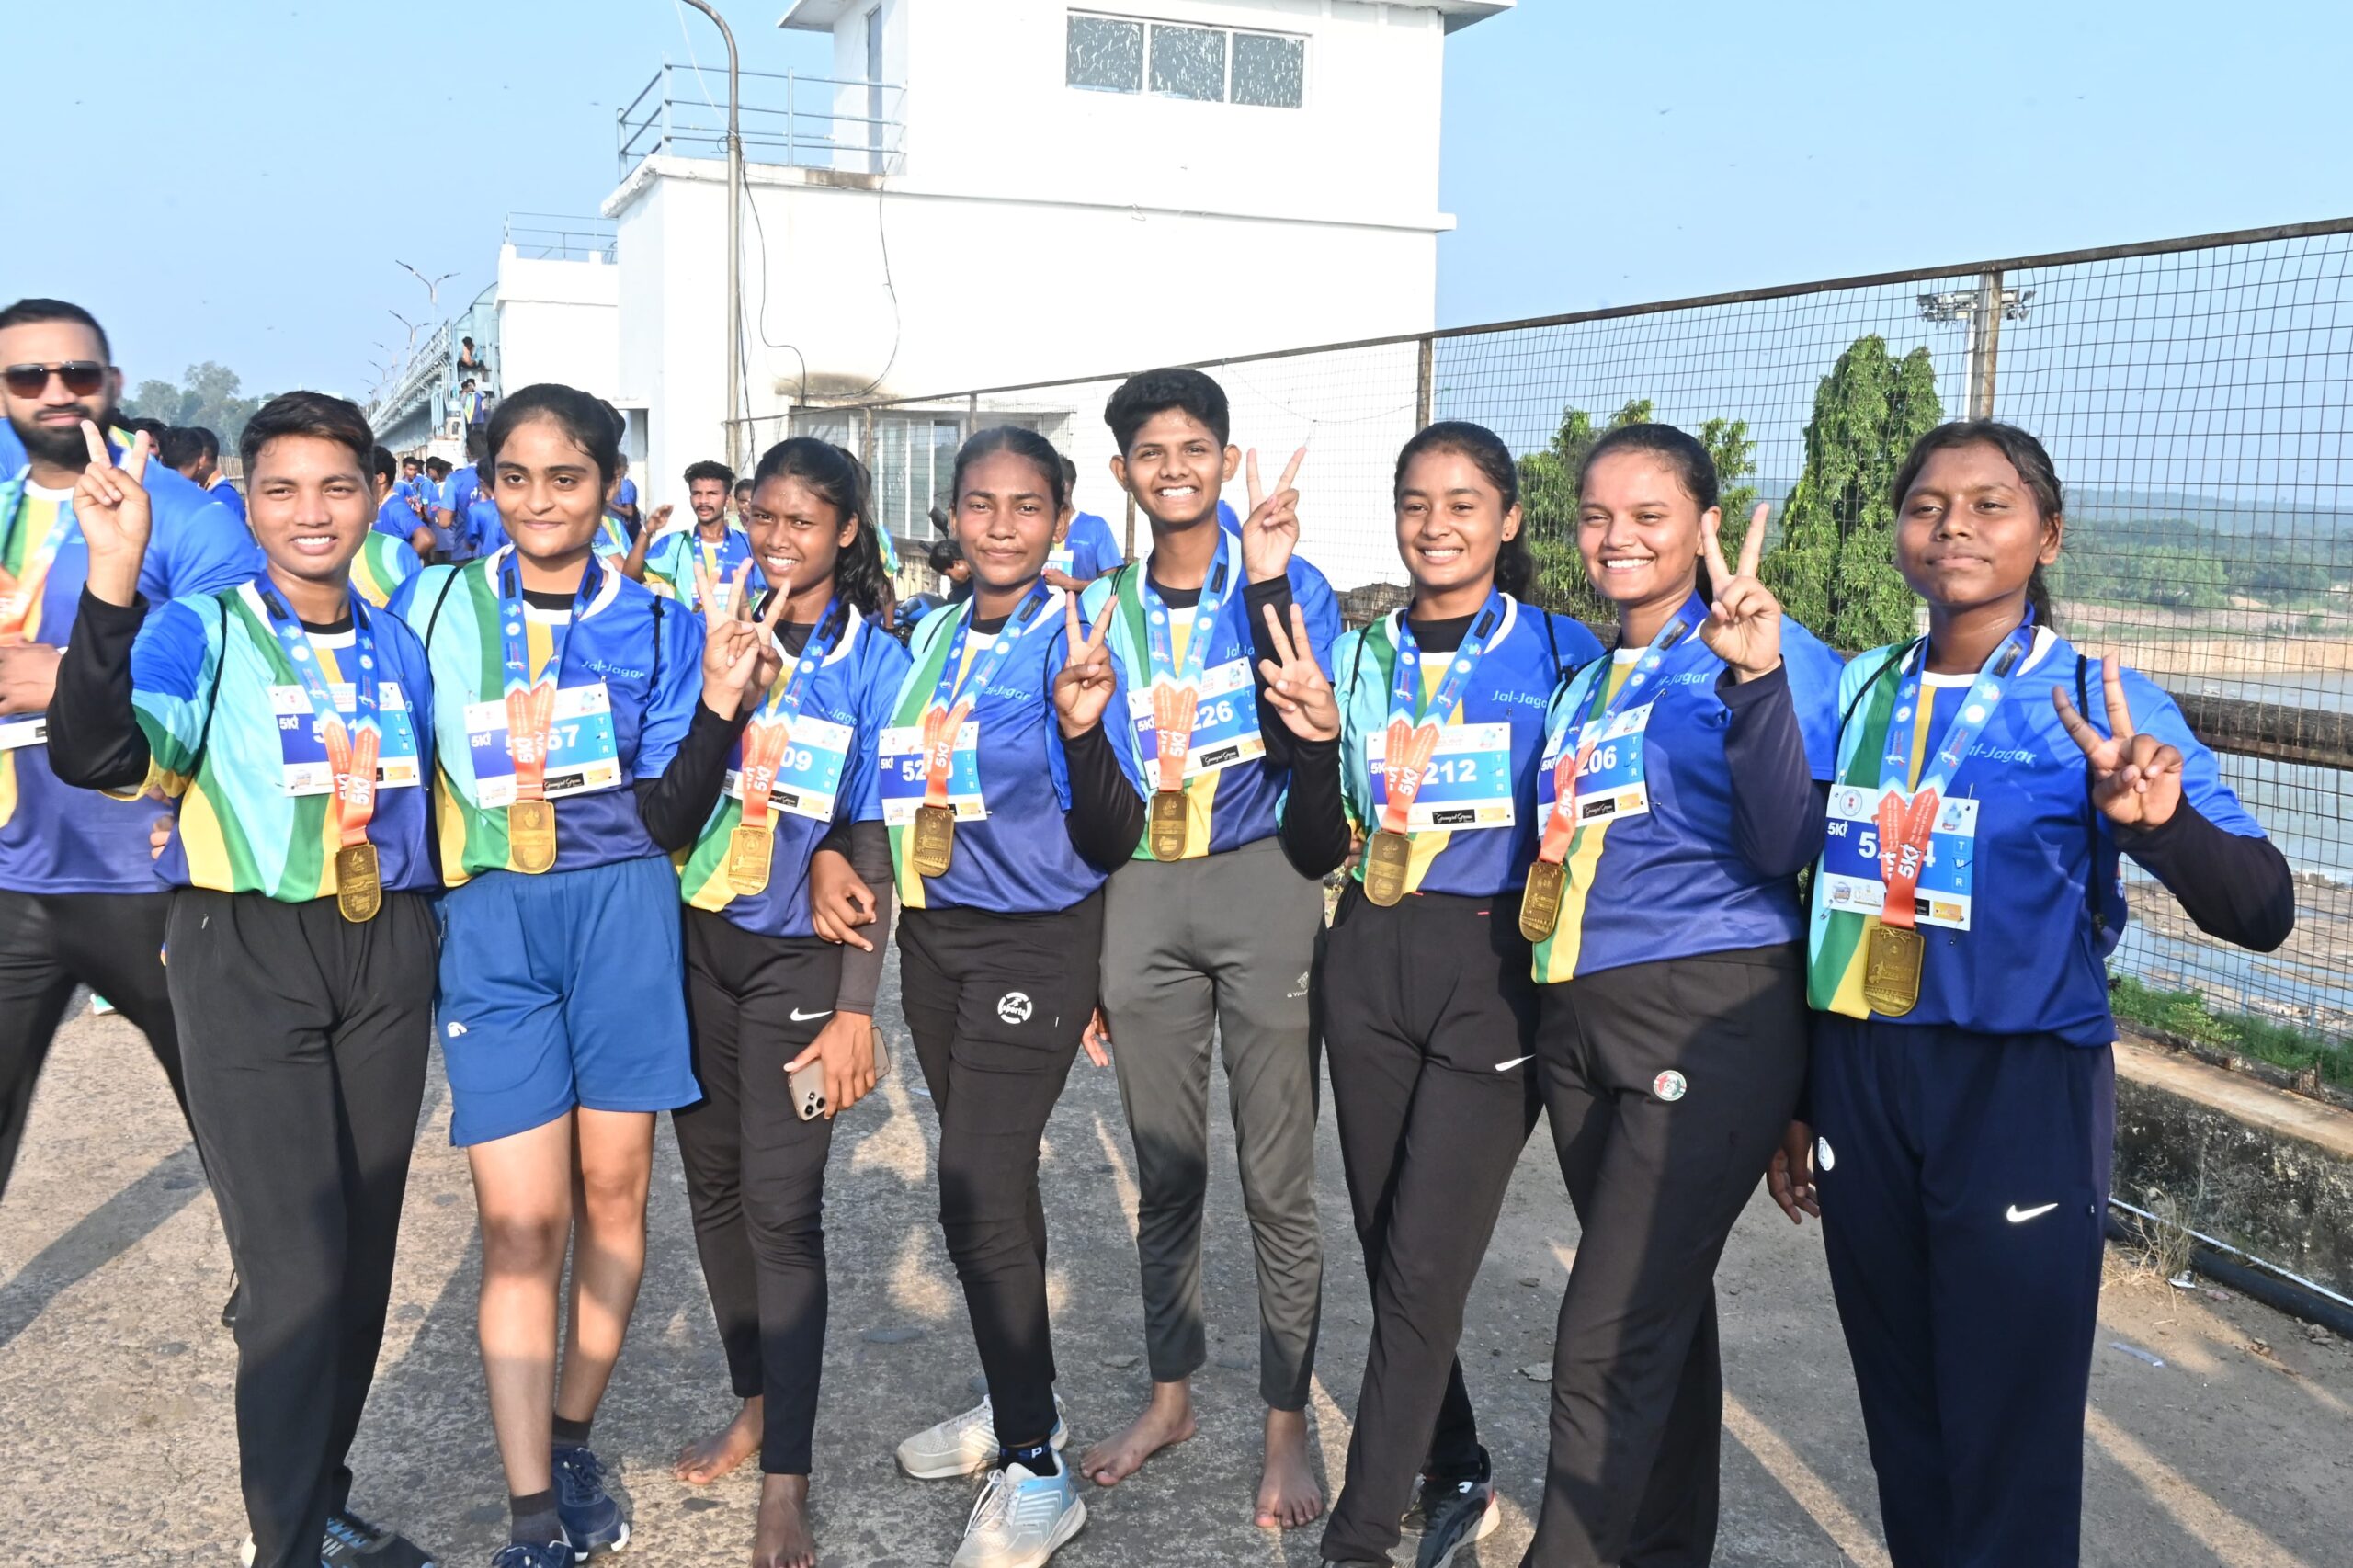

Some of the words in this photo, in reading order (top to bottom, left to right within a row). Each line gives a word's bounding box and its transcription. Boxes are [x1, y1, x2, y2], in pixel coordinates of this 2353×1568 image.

[1192, 700, 1233, 731] 226
[780, 746, 813, 771] 09
[1421, 758, 1478, 785] 212
